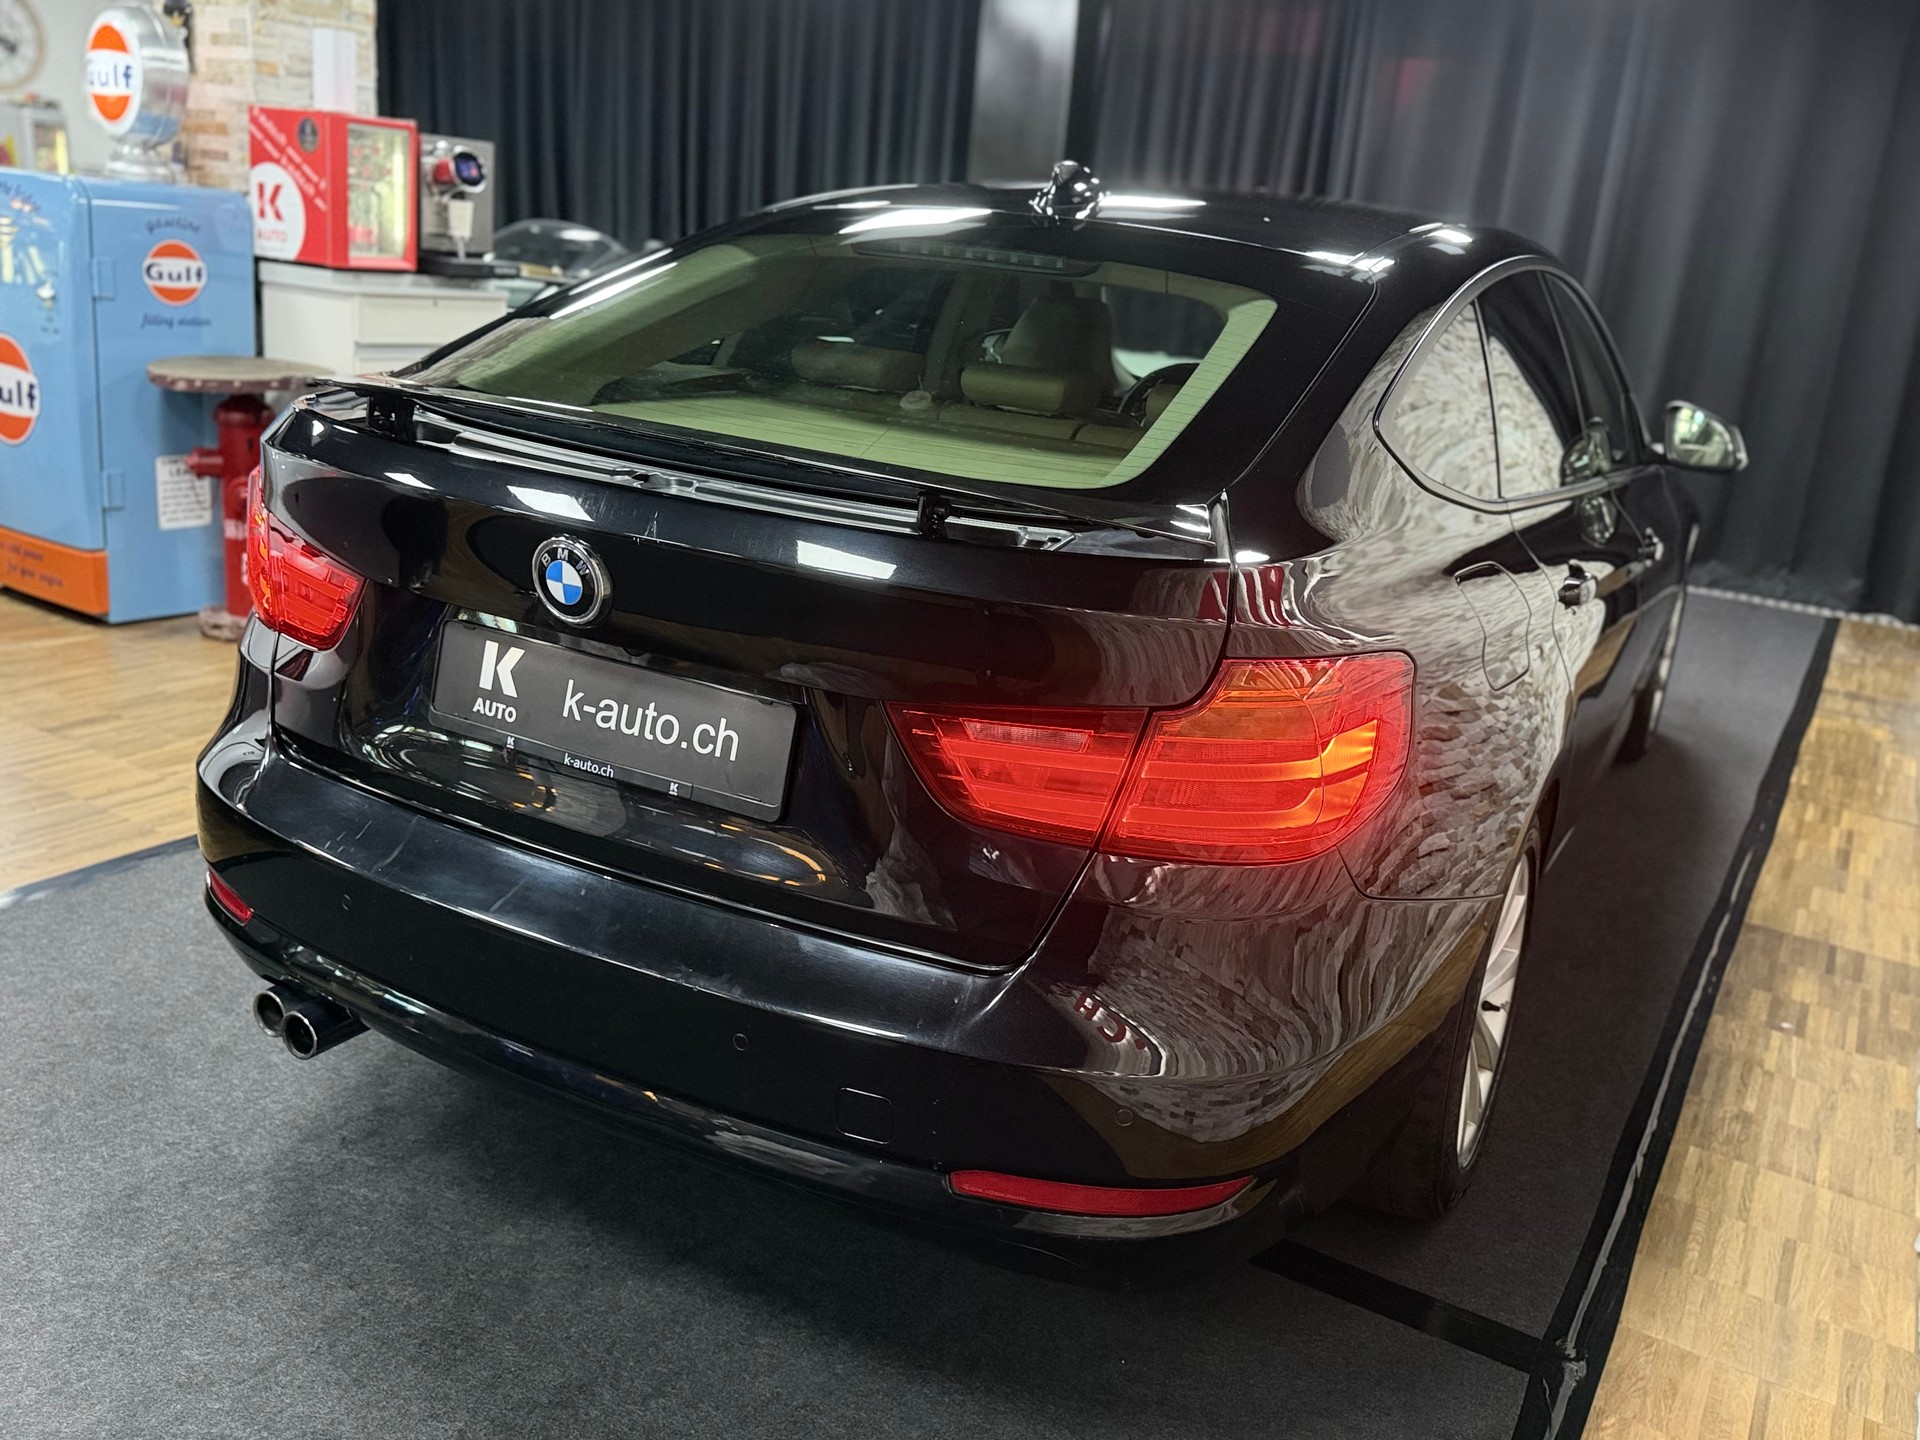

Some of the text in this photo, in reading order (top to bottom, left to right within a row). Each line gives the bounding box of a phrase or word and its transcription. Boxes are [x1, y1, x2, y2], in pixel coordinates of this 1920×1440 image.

[257, 182, 283, 221] K
[145, 262, 203, 283] Gulf
[0, 380, 36, 410] ulf
[541, 547, 590, 577] BMW
[479, 640, 526, 698] K
[472, 697, 518, 723] AUTO
[562, 678, 740, 762] k-auto.ch
[563, 752, 614, 778] k-auto.ch
